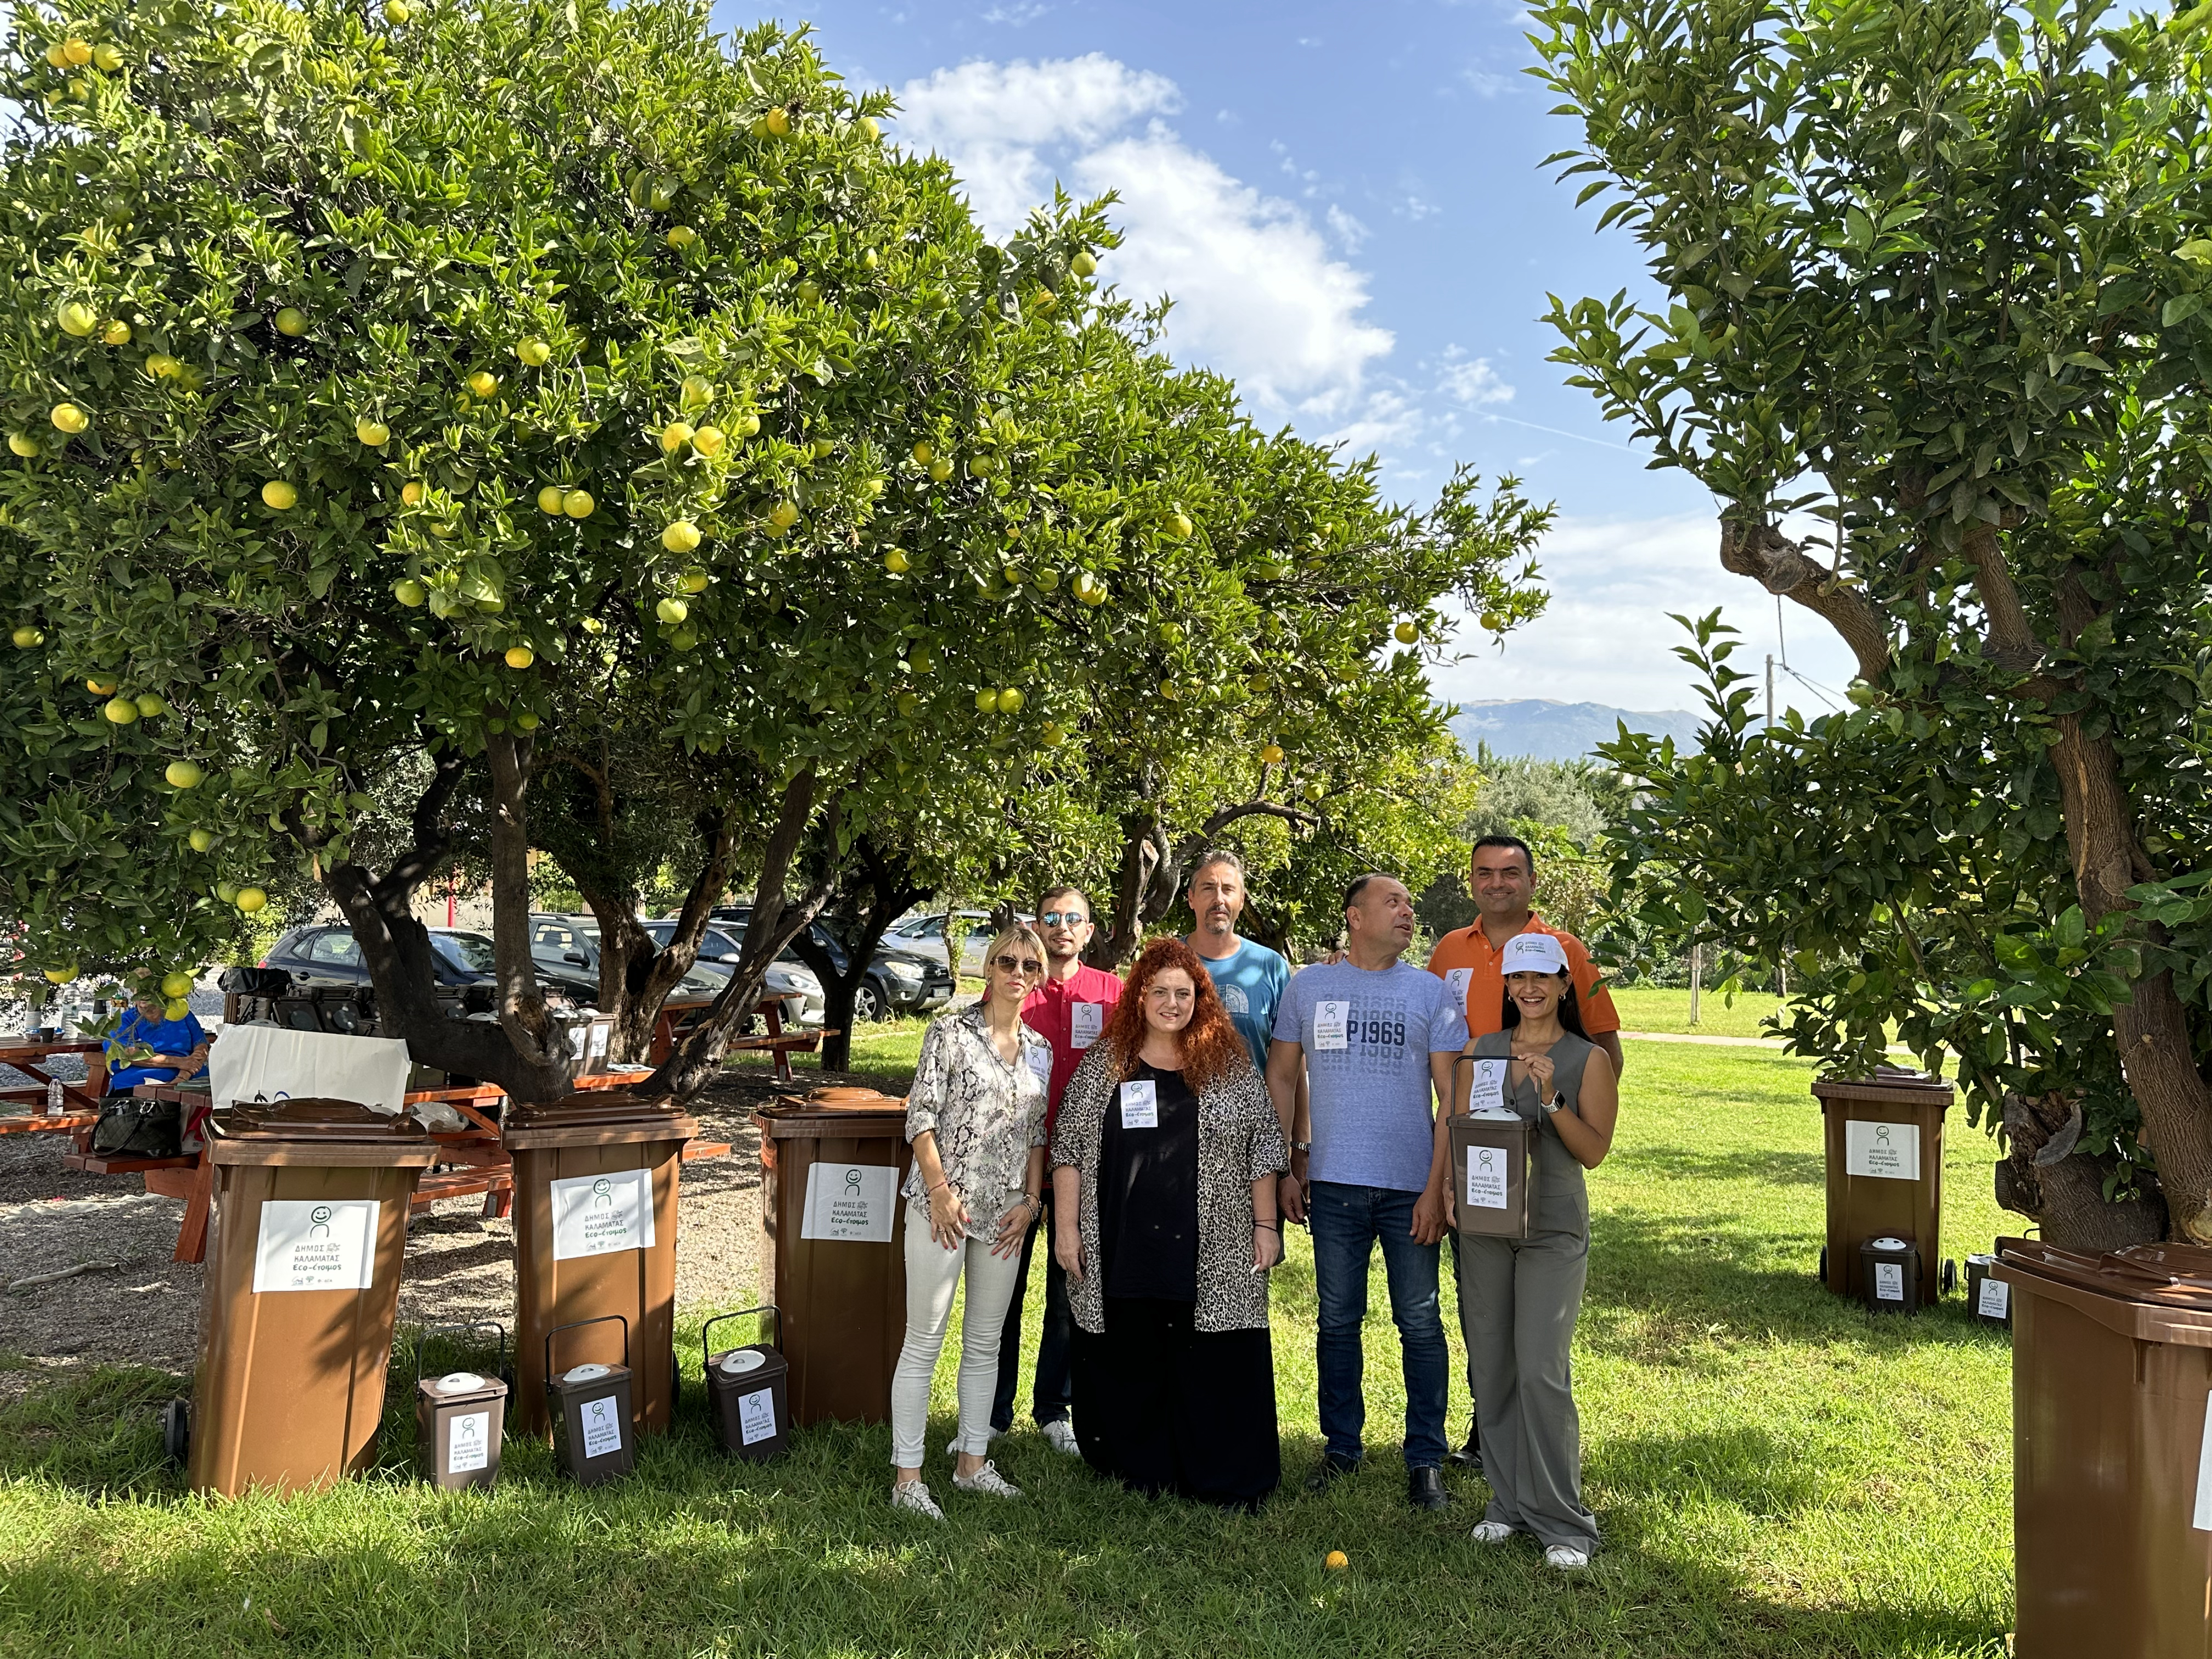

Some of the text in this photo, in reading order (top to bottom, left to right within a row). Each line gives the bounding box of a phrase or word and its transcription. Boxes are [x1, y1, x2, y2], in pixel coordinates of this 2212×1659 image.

[1347, 1020, 1405, 1046] P1969
[585, 1213, 609, 1222] ΔΗΜΟΣ
[585, 1220, 624, 1231] ΚΑΛΑΜΑΤΑΣ
